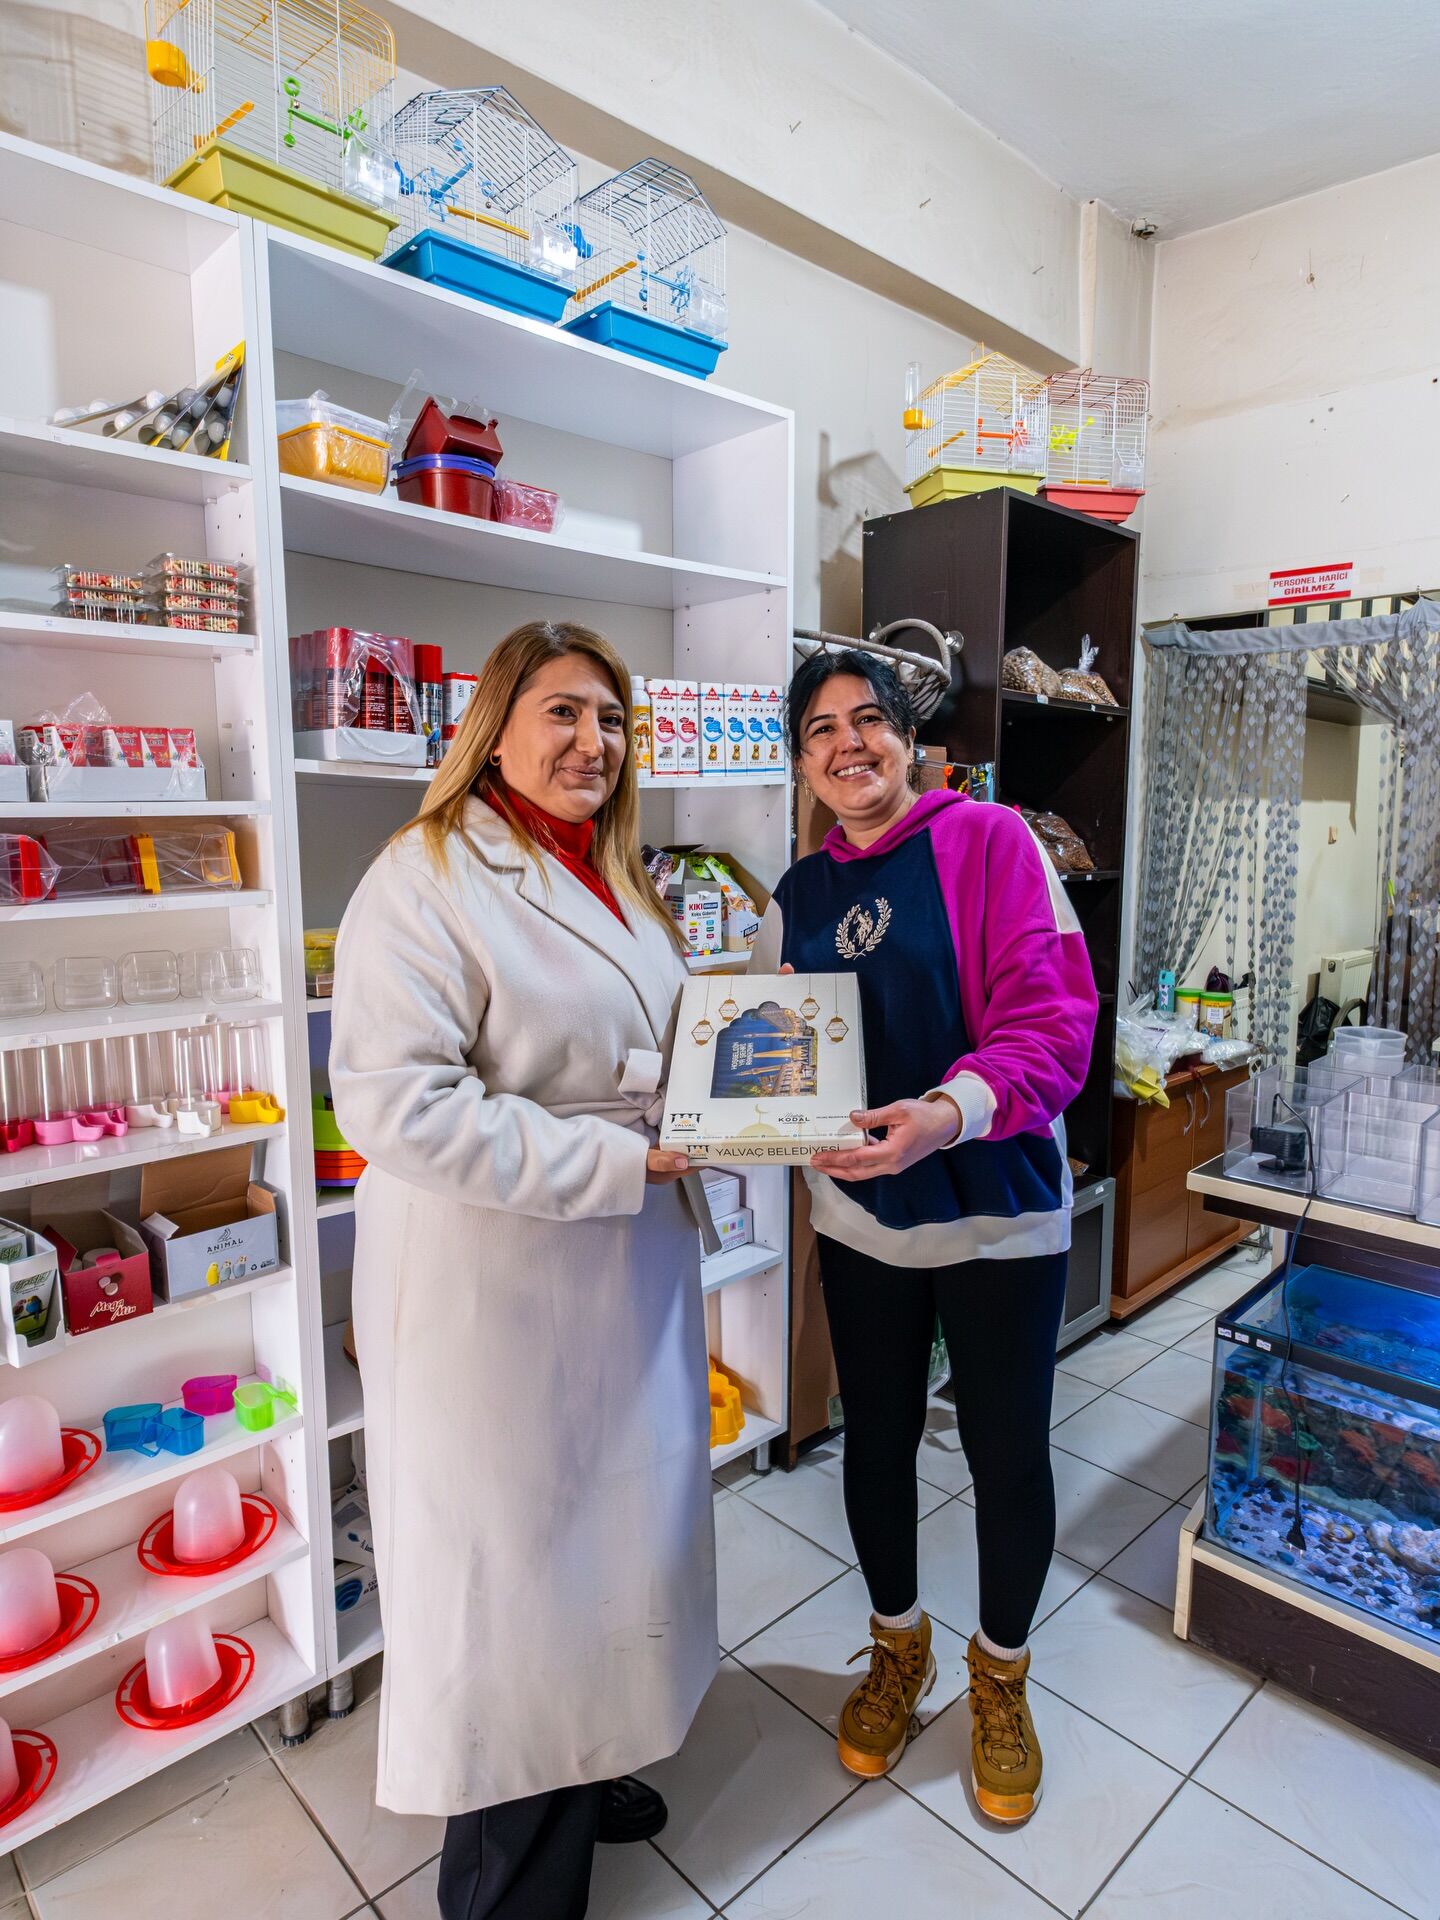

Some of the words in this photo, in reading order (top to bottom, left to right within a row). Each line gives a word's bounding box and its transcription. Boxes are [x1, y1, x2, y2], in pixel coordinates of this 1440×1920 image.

[1273, 577, 1316, 588] PERSONEL
[1284, 583, 1335, 595] GİRİLMEZ
[688, 903, 703, 911] KIKI
[715, 1148, 764, 1158] YALVAÇ
[767, 1144, 840, 1156] BELEDİYESİ
[206, 1238, 244, 1253] ANIMAL
[89, 1298, 125, 1318] Mega
